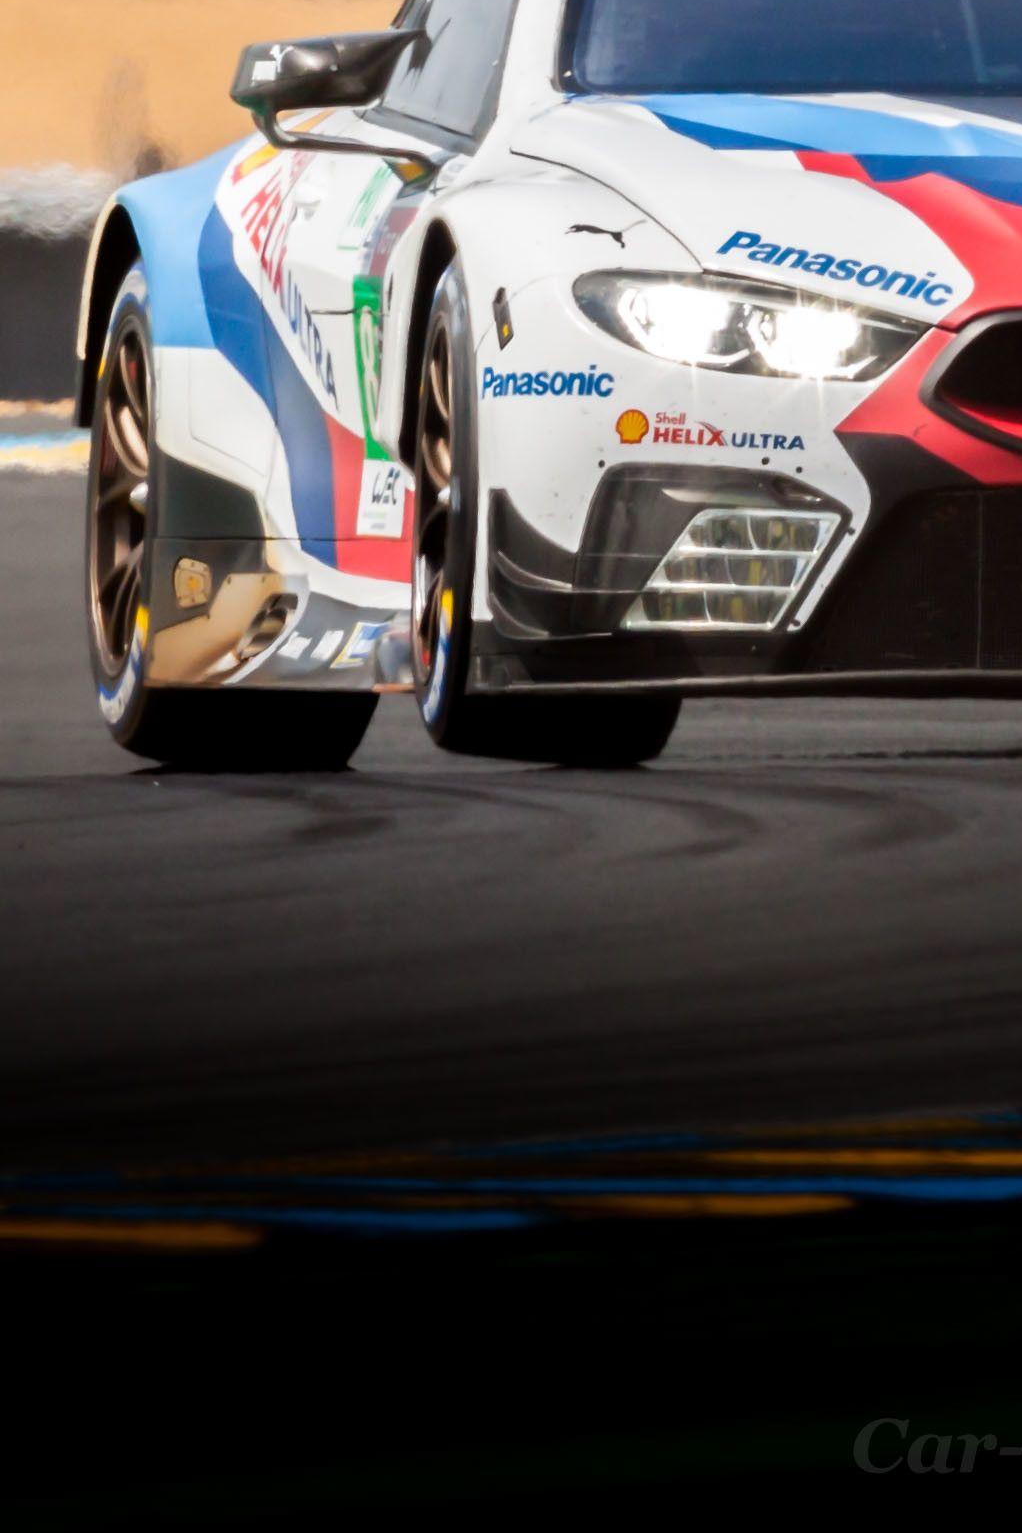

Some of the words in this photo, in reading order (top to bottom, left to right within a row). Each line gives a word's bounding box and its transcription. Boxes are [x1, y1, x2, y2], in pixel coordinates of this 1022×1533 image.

[717, 230, 953, 307] Panasonic
[481, 365, 615, 399] Panasonic
[654, 412, 687, 425] Shell
[652, 421, 728, 447] HELIX
[731, 432, 805, 451] ULTRA
